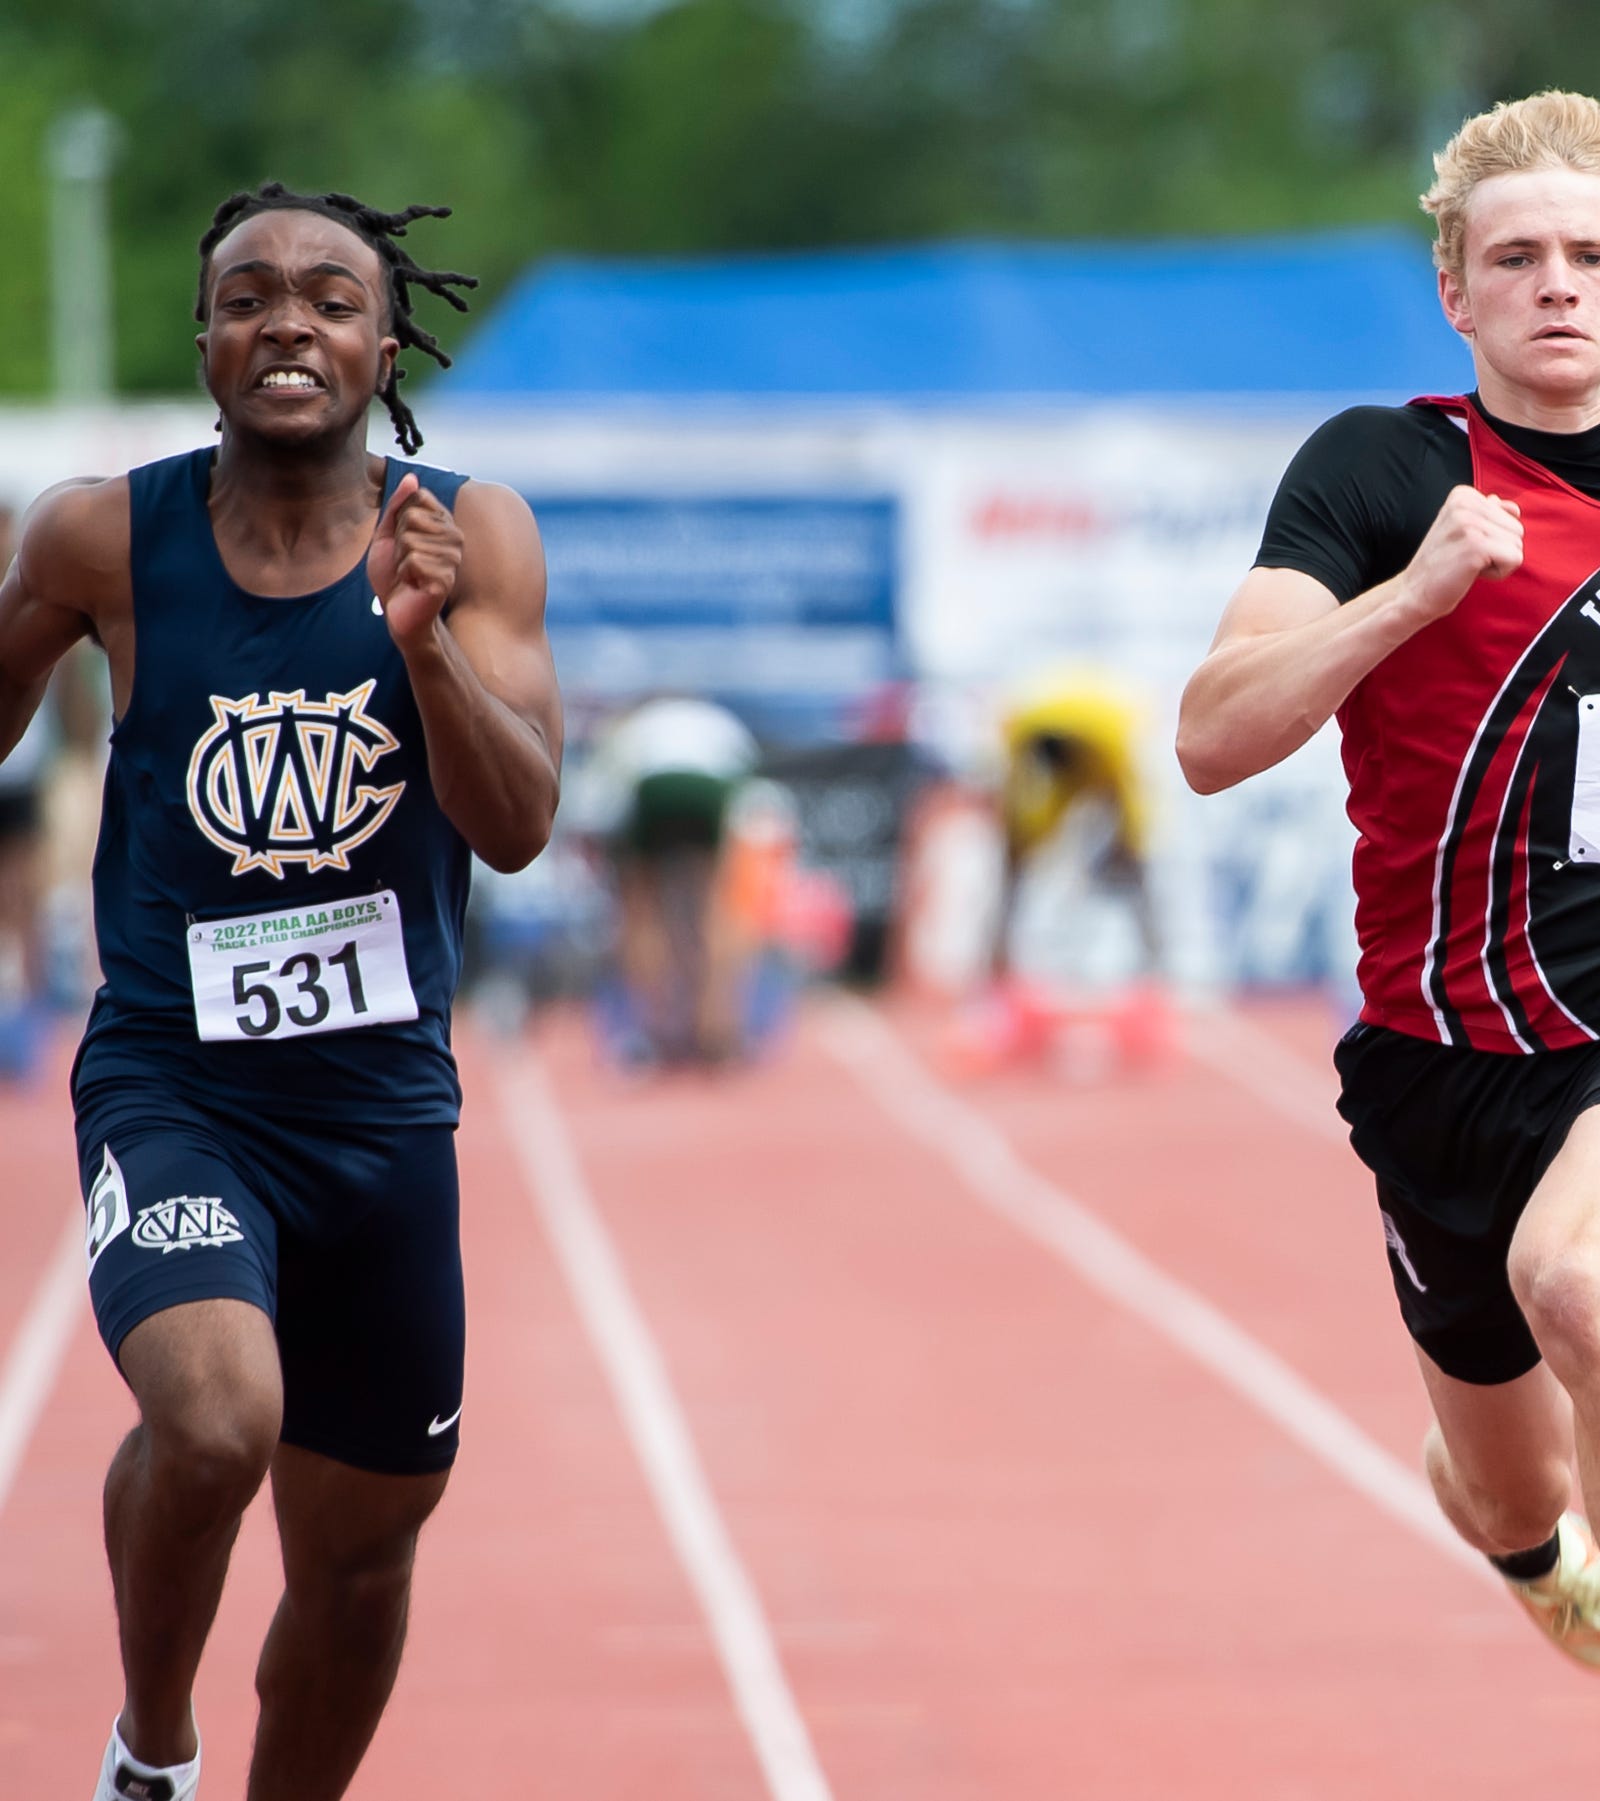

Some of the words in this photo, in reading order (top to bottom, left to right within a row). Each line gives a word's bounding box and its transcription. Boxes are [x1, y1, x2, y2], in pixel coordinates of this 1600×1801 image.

[211, 939, 247, 952] TRACK
[249, 939, 257, 947] &
[260, 934, 288, 945] FIELD
[291, 913, 382, 940] CHAMPIONSHIPS
[213, 923, 257, 942] 2022
[262, 916, 300, 933] PIAA
[306, 911, 329, 926] AA
[333, 901, 377, 920] BOYS
[232, 940, 368, 1037] 531
